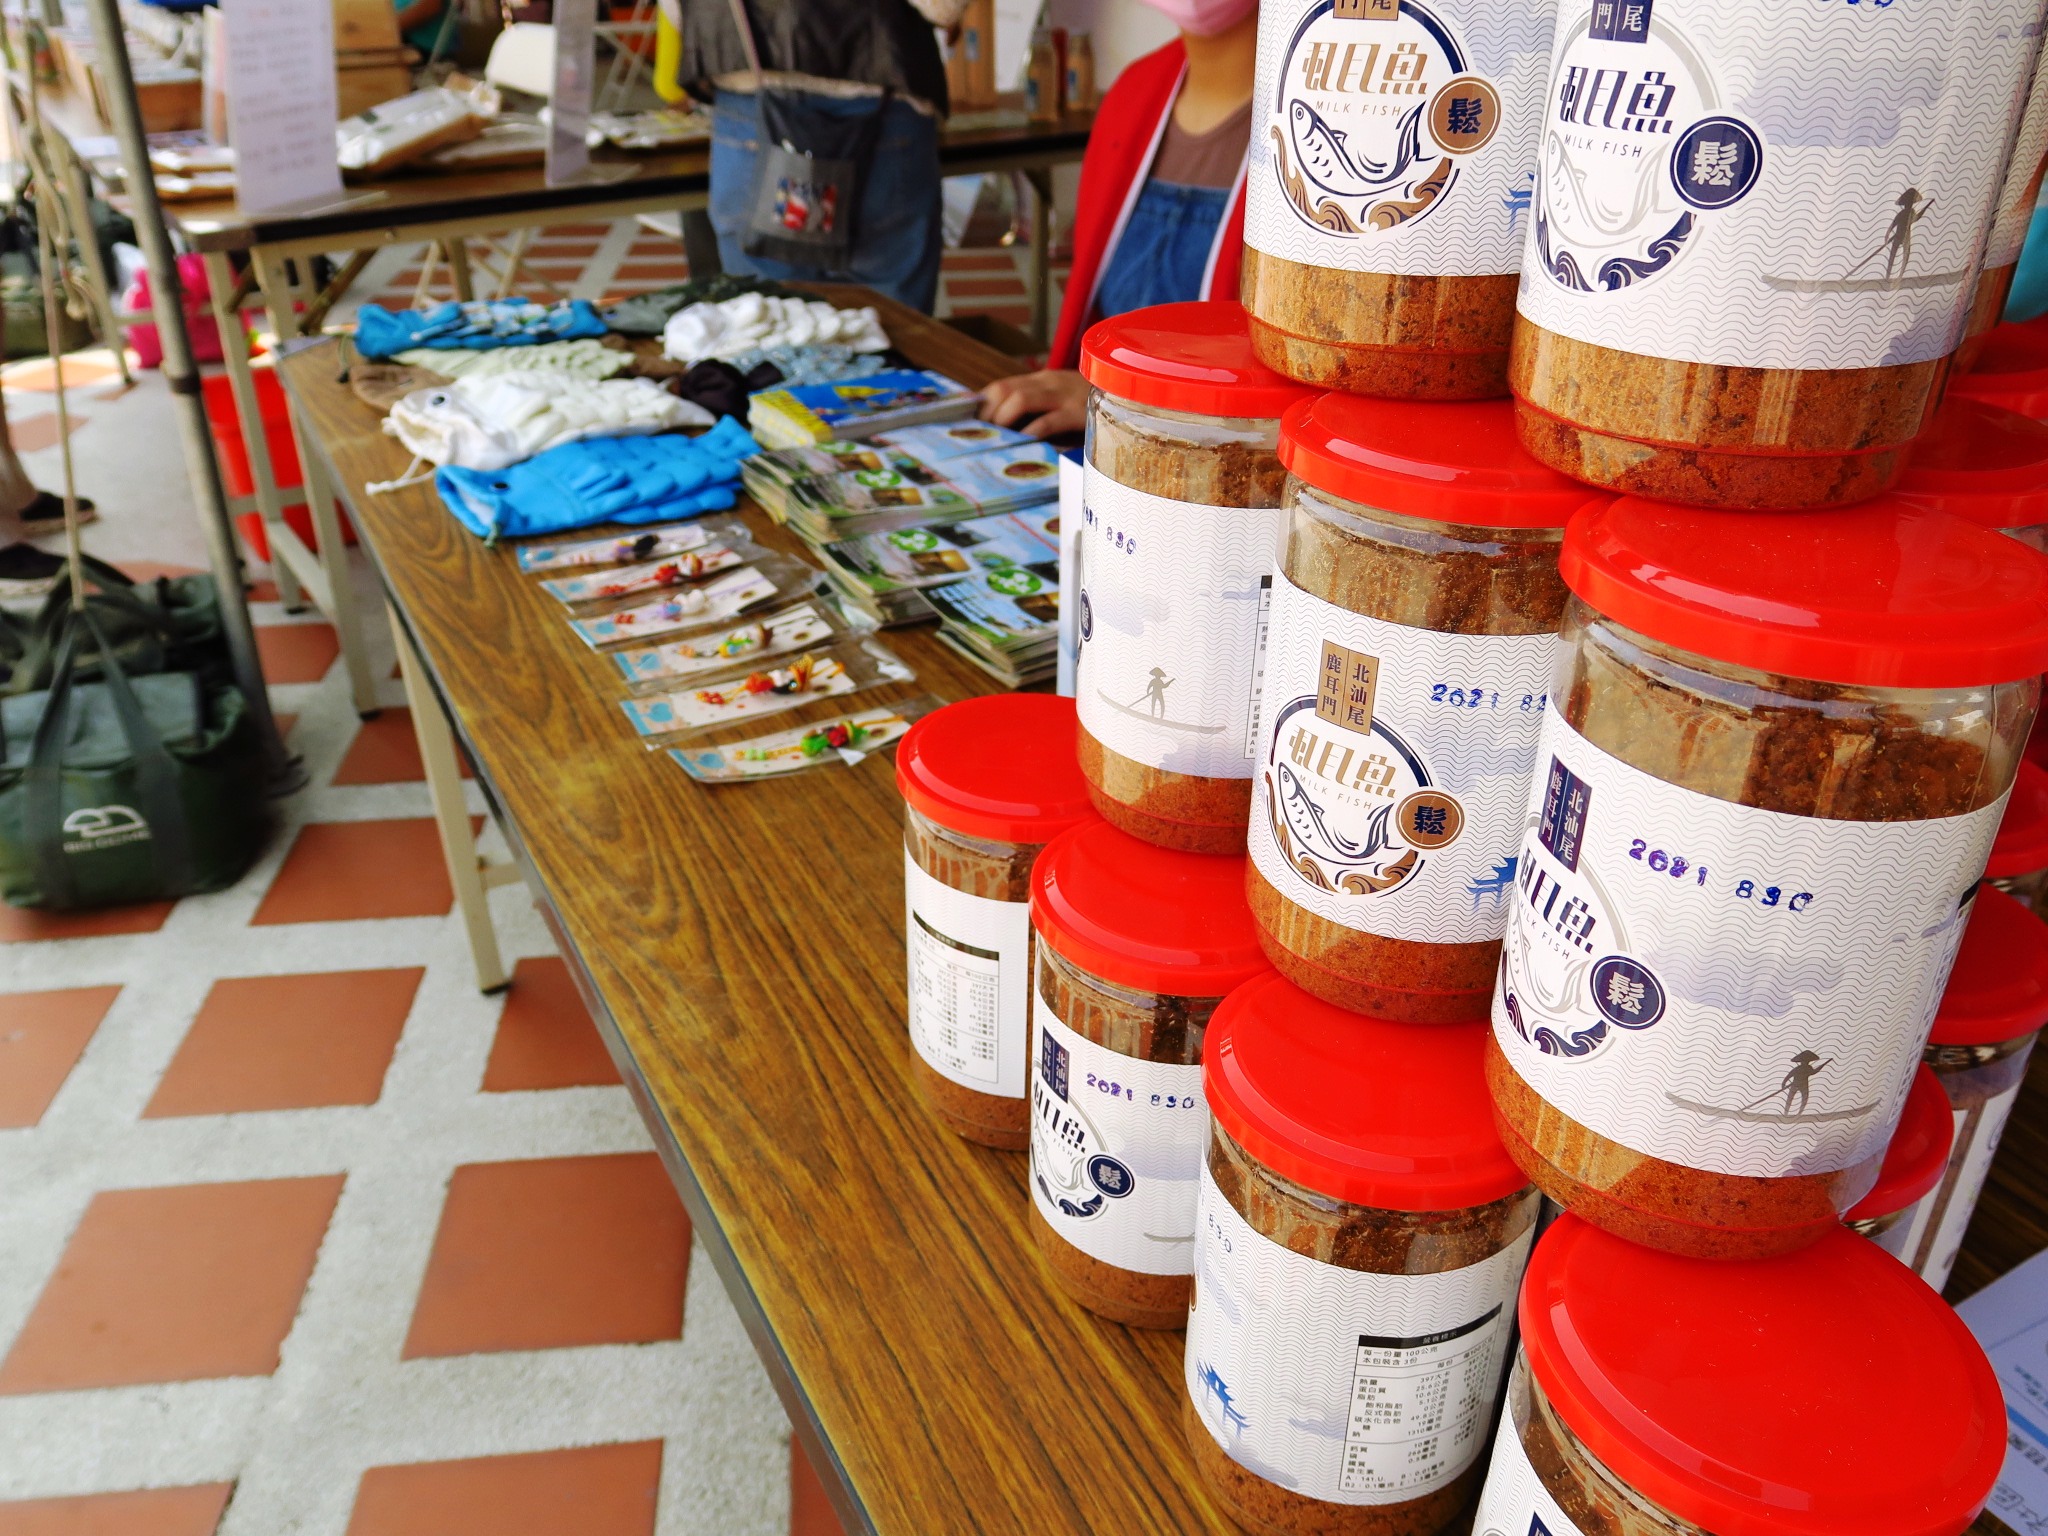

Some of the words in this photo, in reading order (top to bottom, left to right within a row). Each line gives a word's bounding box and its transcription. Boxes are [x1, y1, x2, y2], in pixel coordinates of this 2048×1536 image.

[1594, 2, 1613, 30] 門
[1621, 4, 1645, 32] 尾
[1315, 100, 1351, 115] MILK
[1362, 104, 1401, 117] FISH
[1446, 97, 1482, 135] 鬆
[1563, 133, 1594, 151] MILK
[1603, 140, 1643, 159] FISH
[1693, 140, 1738, 187] 鬆
[1319, 652, 1342, 717] 鹿耳門
[1431, 683, 1500, 709] 2021
[1298, 773, 1329, 796] MILK
[1337, 791, 1373, 812] FISH
[1413, 804, 1447, 836] 鬆
[1628, 838, 1709, 887] 2021
[1518, 902, 1538, 930] MILK
[1541, 932, 1571, 961] FISH
[1606, 970, 1646, 1016] 鬆
[1086, 1072, 1133, 1102] 2021
[1150, 1094, 1195, 1109] 830
